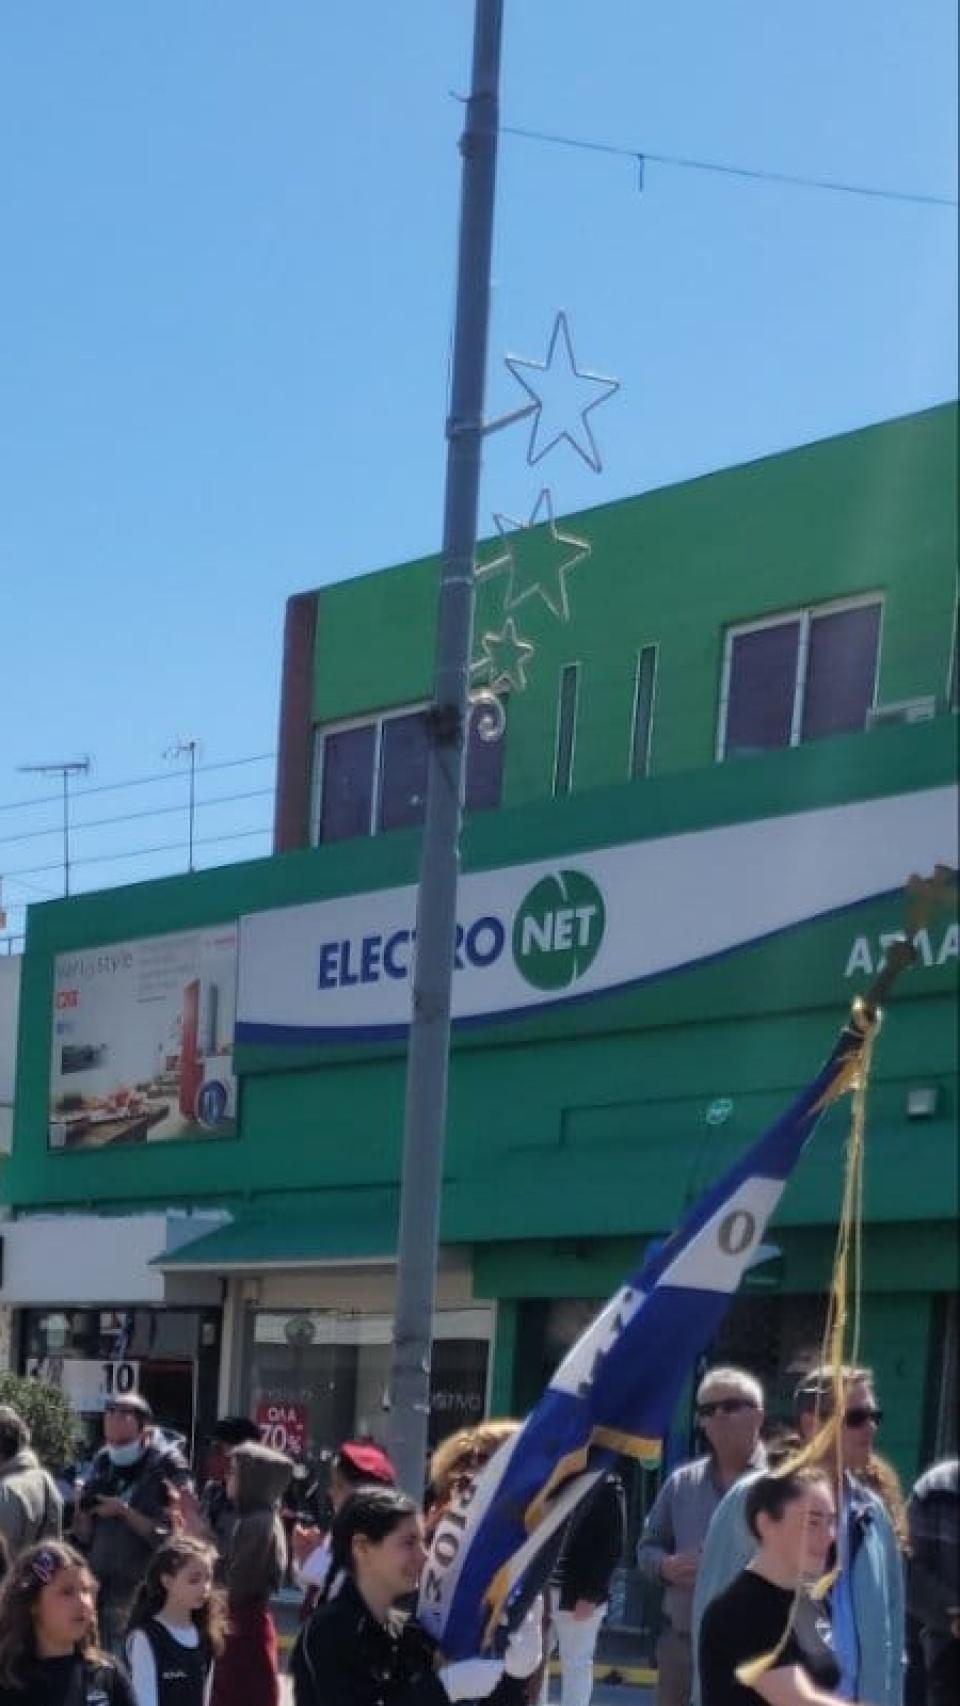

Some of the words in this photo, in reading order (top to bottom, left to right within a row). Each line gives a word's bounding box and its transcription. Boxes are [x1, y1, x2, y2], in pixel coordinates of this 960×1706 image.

[318, 916, 505, 990] ELECRO
[521, 905, 597, 955] NET
[103, 1363, 135, 1394] 10
